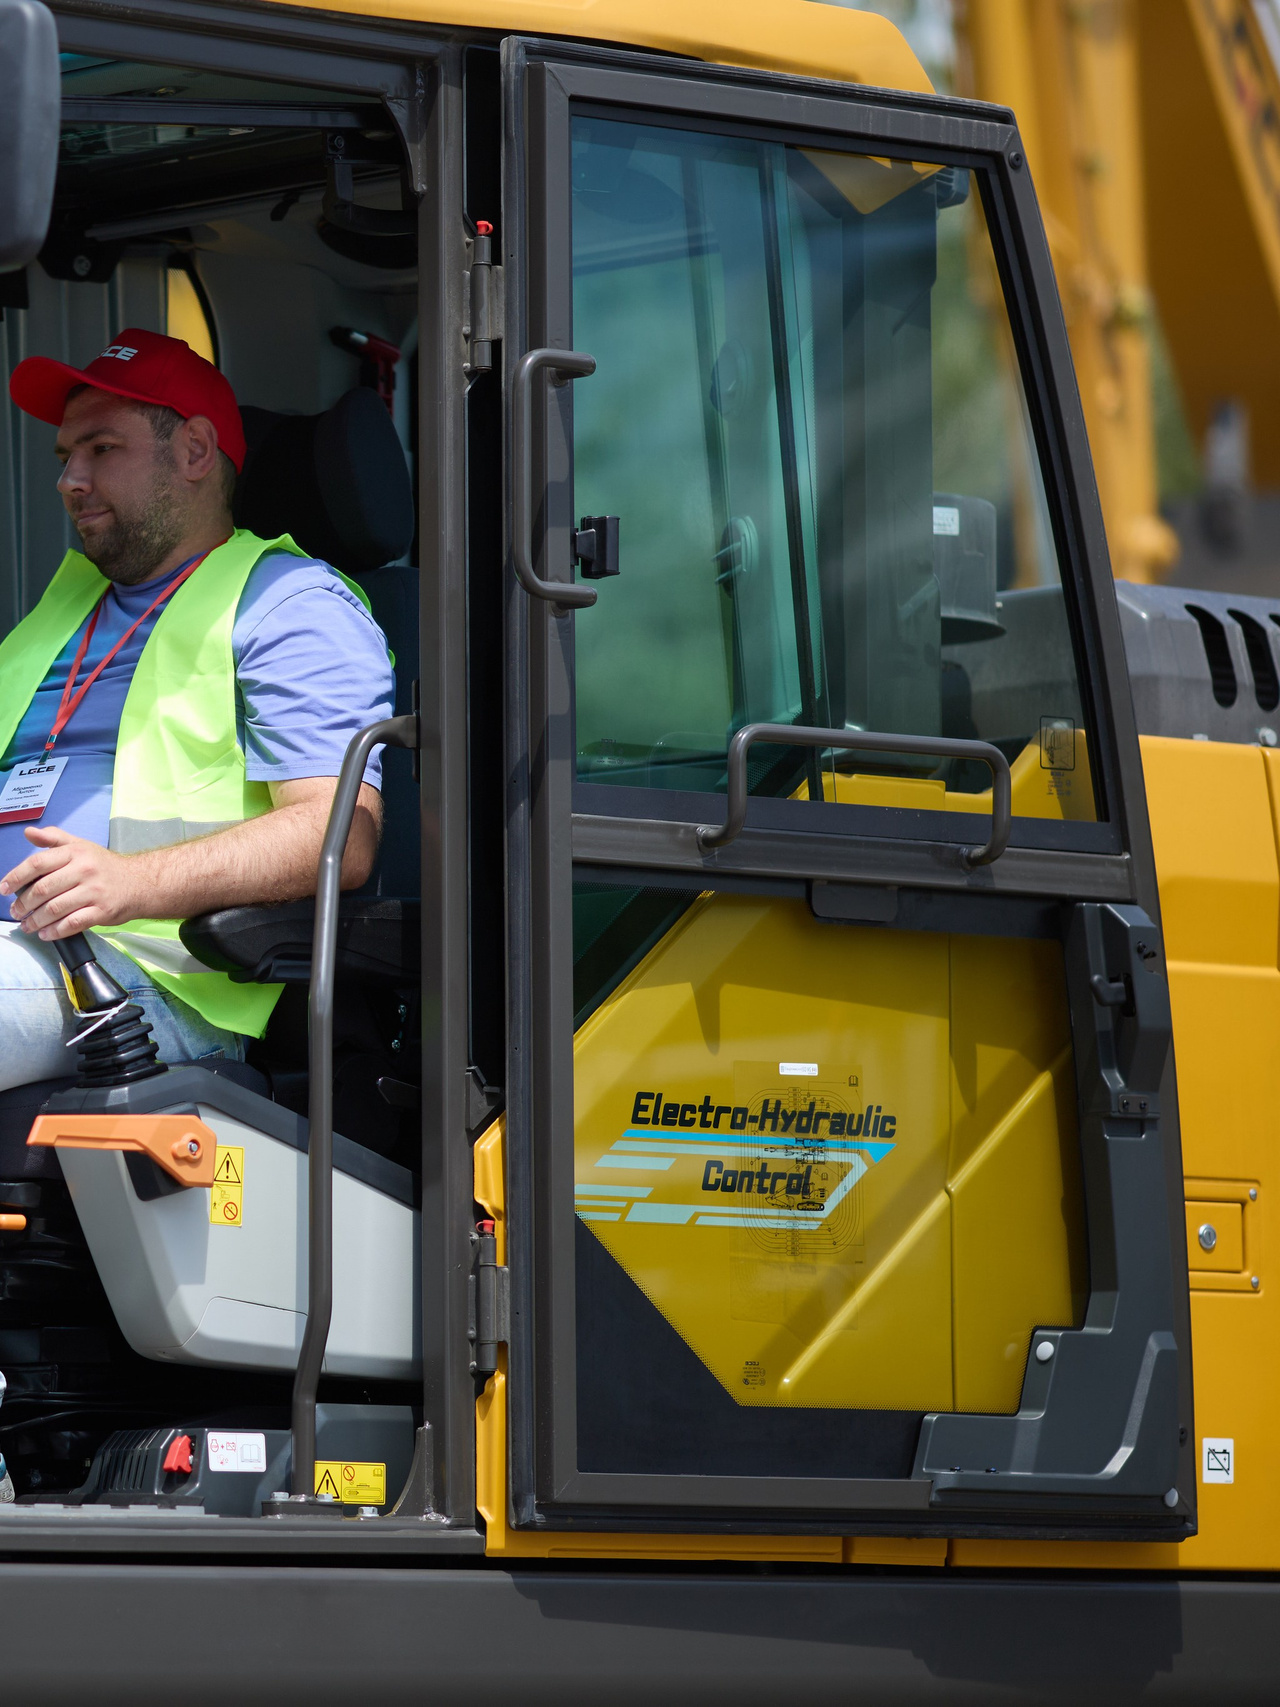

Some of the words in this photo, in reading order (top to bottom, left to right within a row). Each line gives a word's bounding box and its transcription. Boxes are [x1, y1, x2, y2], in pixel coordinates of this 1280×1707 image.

[18, 765, 55, 776] LGCE
[631, 1091, 898, 1139] Electro-Hydraulic
[701, 1160, 812, 1196] Control
